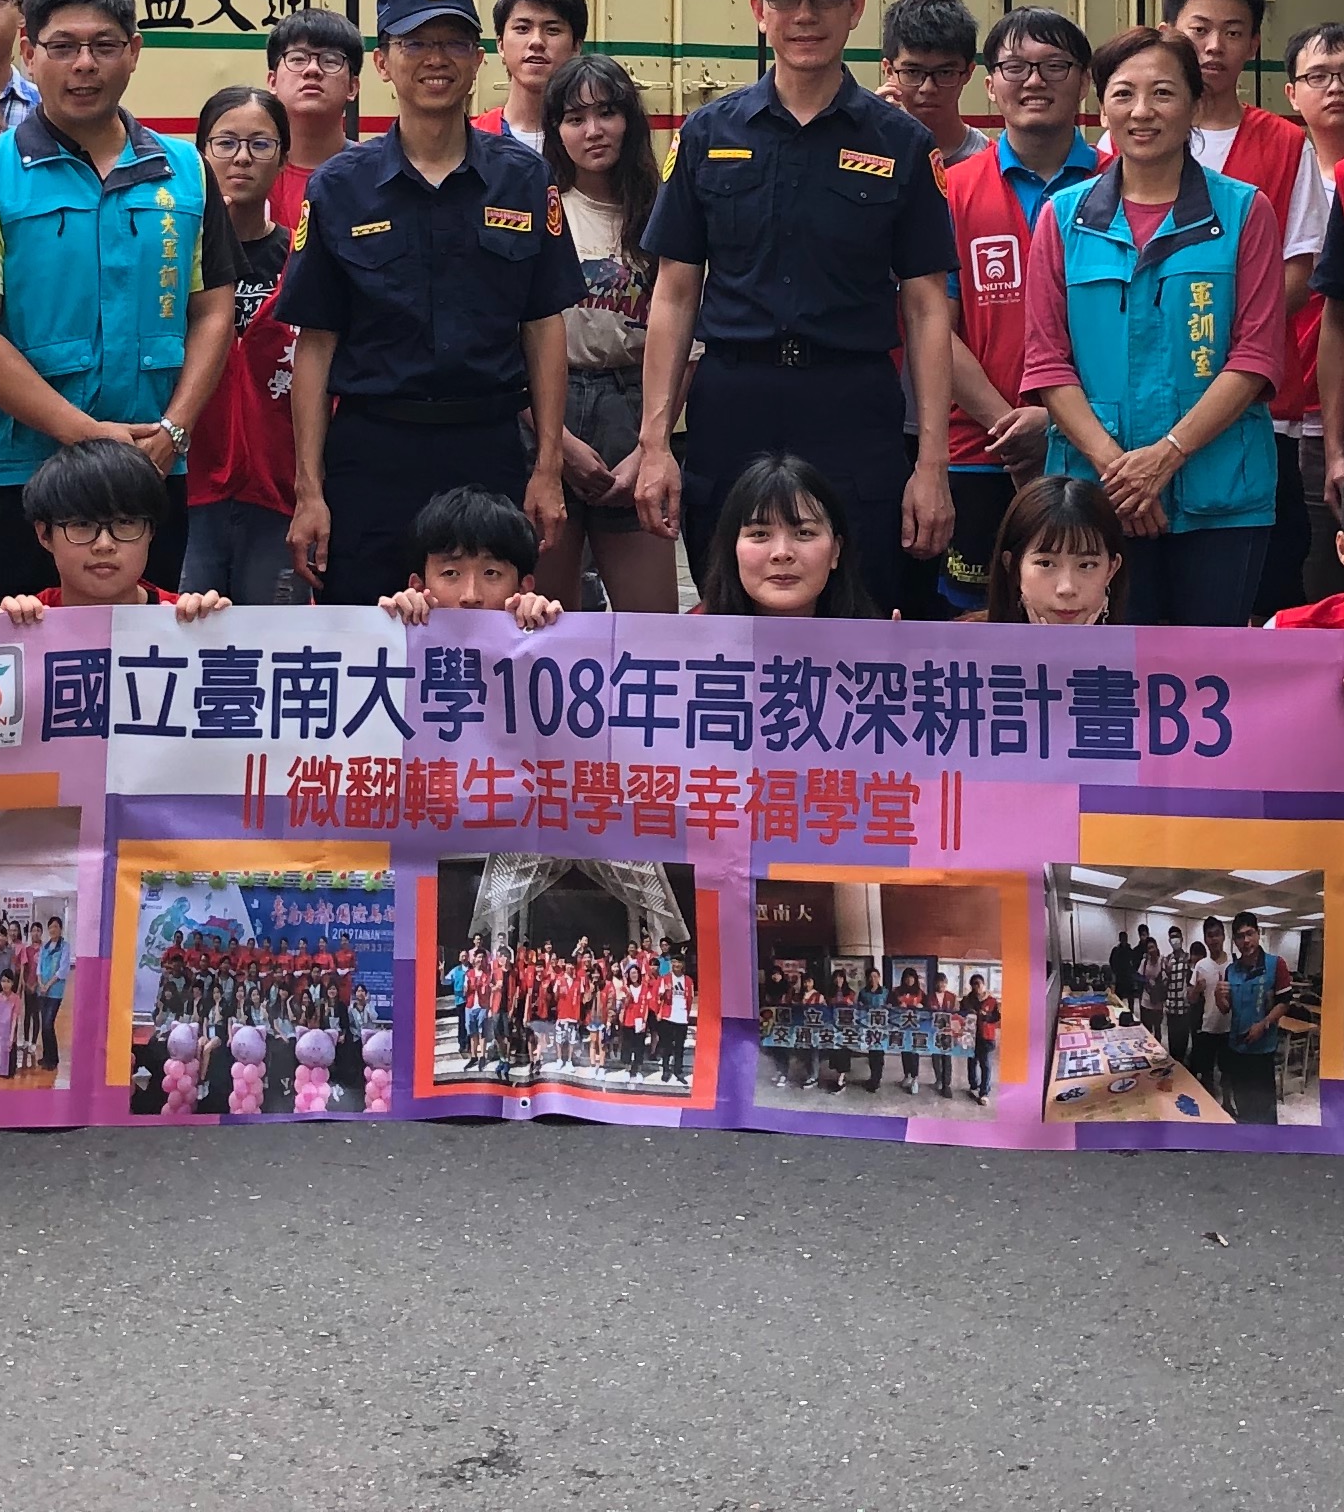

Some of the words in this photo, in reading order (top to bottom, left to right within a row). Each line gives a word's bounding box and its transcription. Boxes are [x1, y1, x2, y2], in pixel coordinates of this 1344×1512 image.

[1188, 281, 1215, 378] 軍訓室
[42, 645, 1232, 760] 國立臺南大學108年高教深耕計畫B3
